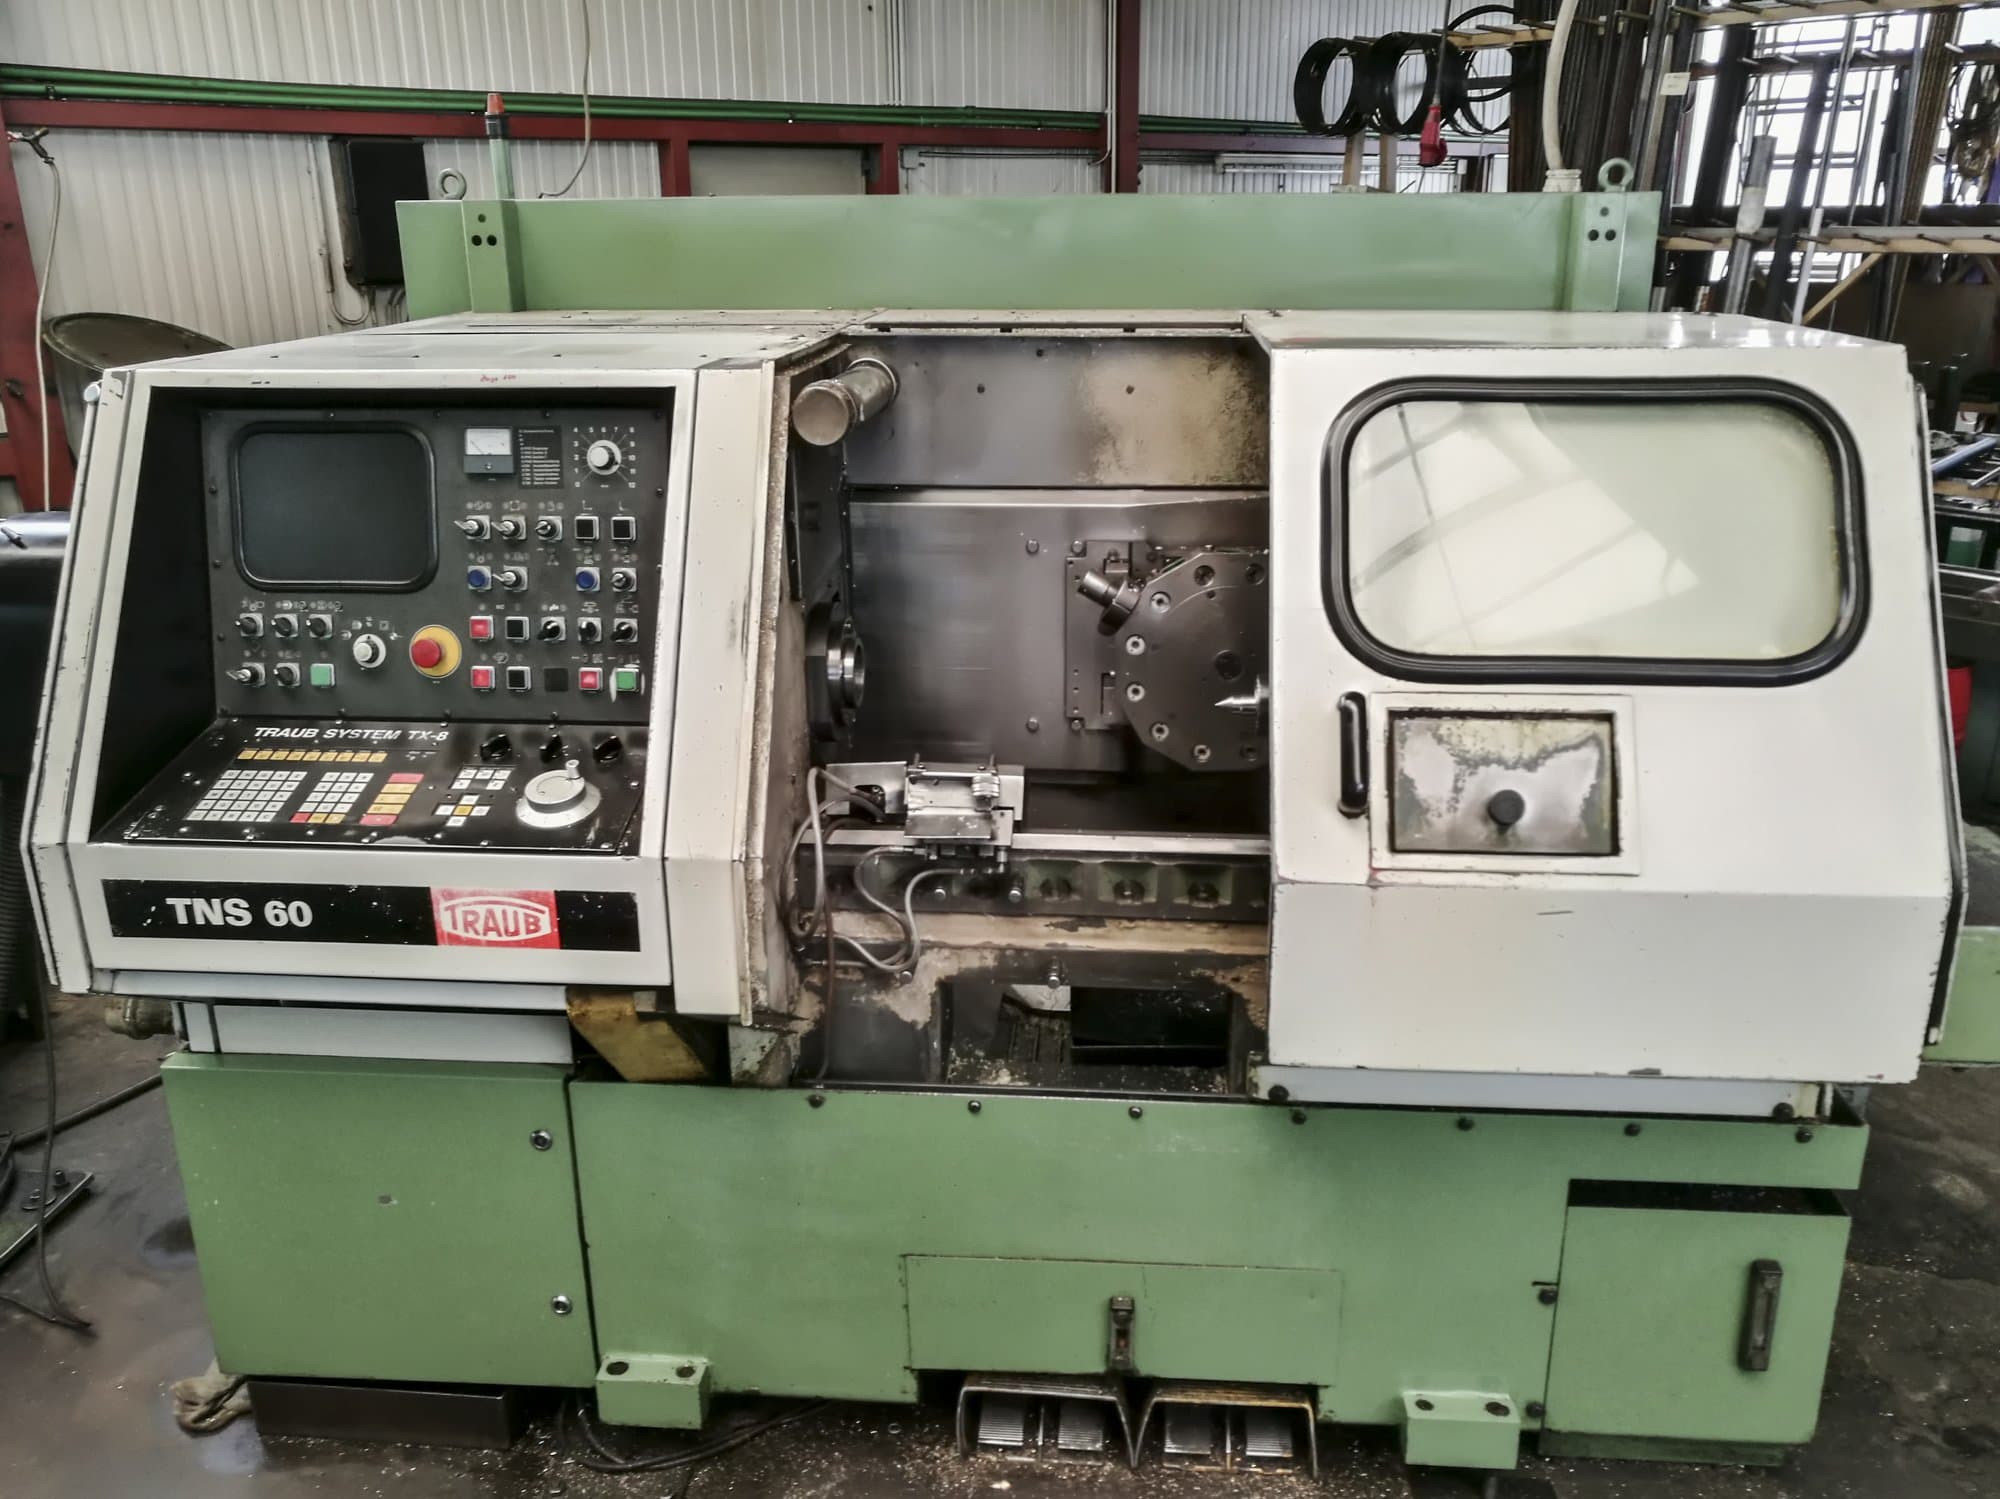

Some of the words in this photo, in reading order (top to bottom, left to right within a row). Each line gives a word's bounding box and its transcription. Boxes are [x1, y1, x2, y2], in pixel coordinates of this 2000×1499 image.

[254, 727, 320, 738] TRAUB
[322, 728, 403, 740] SYSTEM
[407, 730, 449, 741] TX-8
[165, 898, 253, 926] TNS
[264, 900, 313, 928] 60
[444, 901, 546, 937] TRAUB
